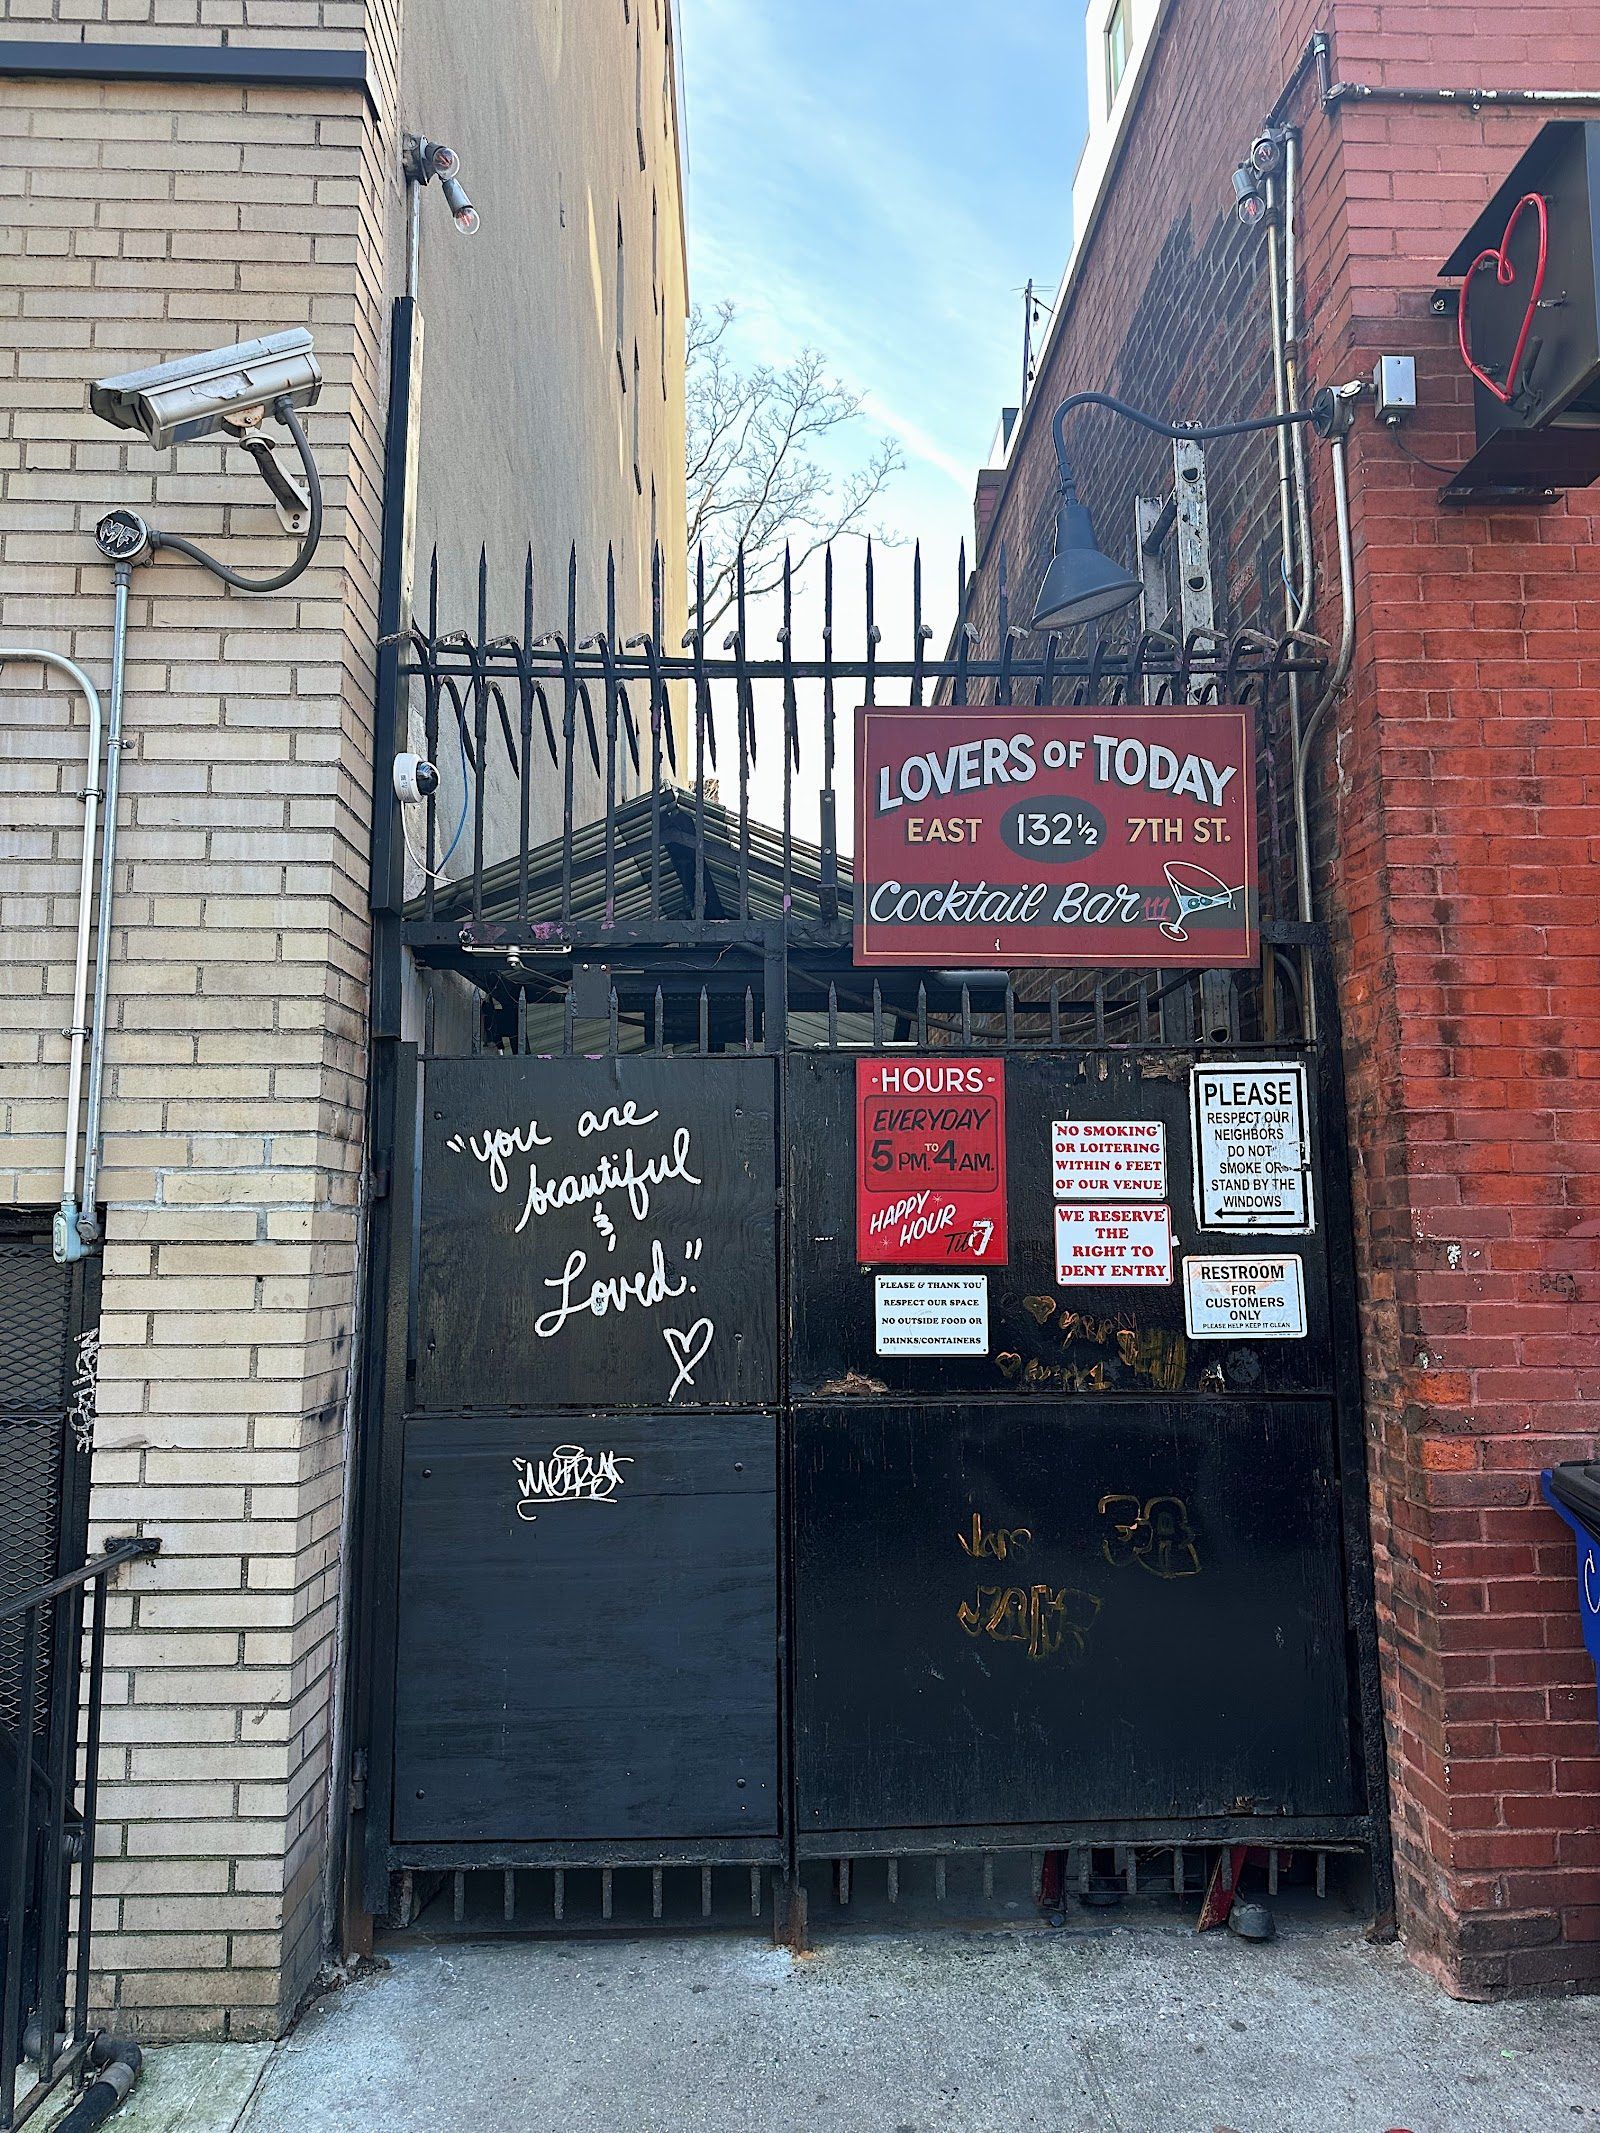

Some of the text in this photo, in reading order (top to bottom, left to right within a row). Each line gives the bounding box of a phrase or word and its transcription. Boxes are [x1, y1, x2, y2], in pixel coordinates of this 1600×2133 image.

[879, 733, 1238, 812] LOVERS OF TODAY
[907, 817, 983, 843] EAST
[1127, 818, 1183, 843] 7TH
[1193, 818, 1232, 843] ST.
[869, 880, 1142, 924] Cocktail Bar
[1204, 1082, 1293, 1107] PLEASE
[577, 1101, 659, 1137] are
[872, 1108, 991, 1132] EVERYDAY
[1207, 1111, 1290, 1124] RESPECT OUR
[1057, 1125, 1157, 1137] NO SMOKING
[1214, 1129, 1284, 1141] NEIGHBORS
[1055, 1142, 1160, 1154] OR LOITERING
[1228, 1145, 1273, 1157] DO NOT
[871, 1139, 893, 1172] 5
[924, 1143, 939, 1152] TO
[932, 1139, 957, 1171] 4
[958, 1152, 995, 1171] AM.
[1056, 1160, 1162, 1171] WITHIN 6 FEET
[1219, 1161, 1283, 1174] SMOKE OR
[514, 1127, 702, 1233] beautiful
[1055, 1179, 1163, 1191] OF OUR VENUE
[1211, 1178, 1295, 1191] STAND BY THE
[1223, 1195, 1282, 1207] WINDOWS
[869, 1189, 931, 1235] HAPPY
[1059, 1210, 1165, 1222] WE RESERVE
[899, 1203, 957, 1248] HOUR
[1095, 1228, 1129, 1239] THE
[1072, 1246, 1154, 1257] RIGHT TO
[1061, 1265, 1167, 1277] DENY ENTRY
[1202, 1265, 1284, 1280] RESTROOM
[1231, 1285, 1256, 1295] FOR
[1205, 1297, 1285, 1308] CUSTOMERS
[881, 1317, 982, 1325] NO OUTSIDE FOOD OR
[1229, 1310, 1261, 1321] ONLY
